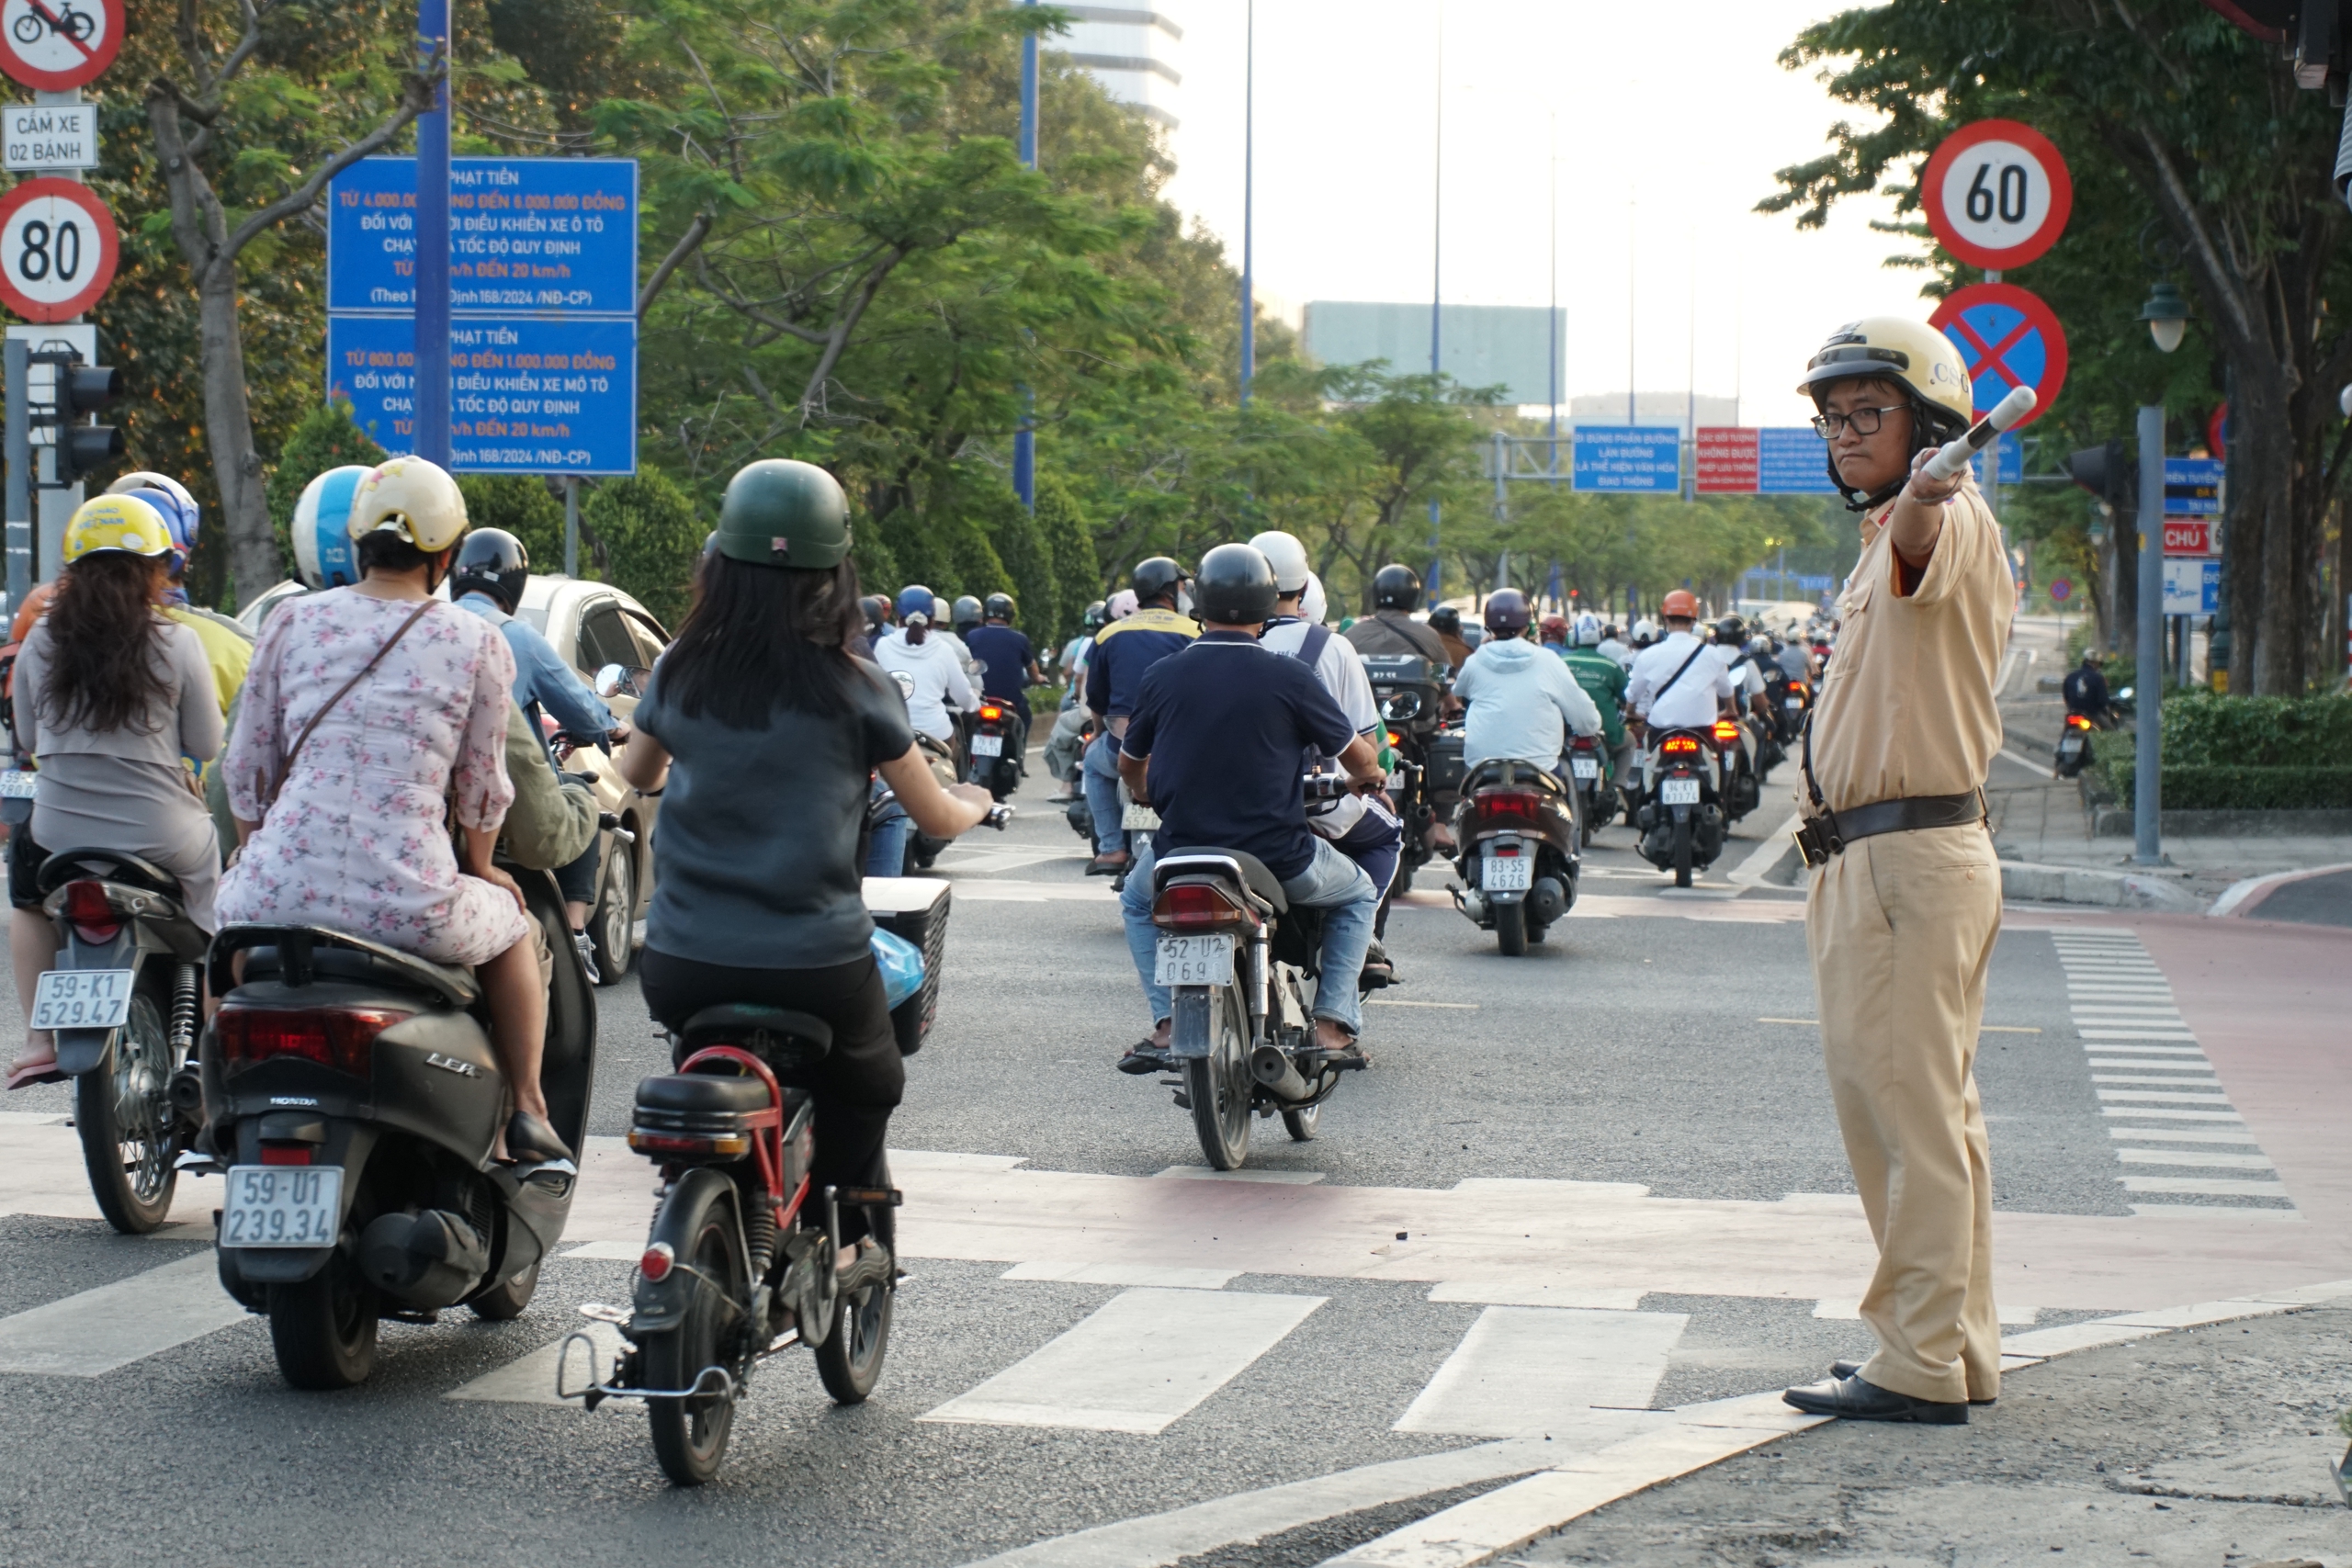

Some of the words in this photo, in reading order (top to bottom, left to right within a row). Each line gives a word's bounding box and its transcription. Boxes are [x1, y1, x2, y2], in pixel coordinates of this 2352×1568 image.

[17, 111, 53, 134] CẤM
[58, 116, 80, 133] XE
[9, 143, 28, 161] 02
[33, 140, 81, 162] BÁNH
[449, 170, 483, 187] PHẠT
[487, 165, 519, 185] TIỀN
[340, 188, 359, 207] TỪ
[363, 193, 417, 209] 4.000.00
[450, 194, 475, 209] NG
[478, 189, 510, 209] ĐẾN
[582, 189, 626, 210] ĐỒNG
[1966, 164, 2028, 224] 60
[361, 211, 386, 230] ĐỐI
[389, 212, 412, 230] VỚI
[464, 210, 497, 231] ĐIỀU
[501, 210, 546, 231] KHIỂN
[549, 218, 568, 232] XE
[571, 214, 582, 232] Ô
[585, 215, 604, 232] TÔ
[19, 220, 80, 281] 80
[383, 237, 417, 255] CHẠ
[458, 234, 486, 254] TỐC
[489, 236, 509, 257] ĐỘ
[512, 240, 541, 254] QUY
[545, 241, 581, 258] ĐỊNH
[477, 258, 508, 277] ĐẾN
[512, 263, 529, 277] 20
[532, 264, 571, 278] km/h
[370, 287, 408, 304] (Theo
[480, 289, 533, 304] 168/2024
[537, 290, 593, 306] /NĐ-CP)
[486, 325, 518, 344] TIỀN
[345, 347, 366, 366] TỪ
[368, 352, 414, 367] 800.00
[471, 348, 503, 367] ĐẾN
[507, 354, 569, 369] 1.000.000
[572, 349, 616, 370] ĐỒNG
[355, 370, 379, 389] ĐỐI
[382, 371, 405, 389] VỚI
[458, 370, 491, 390] ĐIỀU
[494, 370, 538, 391] KHIỂN
[542, 378, 561, 392] XE
[564, 375, 587, 392] MÔ
[590, 376, 608, 392] TÔ
[382, 397, 414, 414] CHẠ
[458, 393, 485, 412] TỐC
[488, 397, 508, 416] ĐỘ
[511, 400, 540, 413] QUY
[544, 400, 580, 416] ĐỊNH
[476, 418, 507, 436] ĐẾN
[511, 422, 528, 437] 20
[531, 423, 571, 437] km/h
[479, 448, 533, 463] 168/2024
[536, 449, 592, 466] /NĐ-CP)
[2165, 525, 2200, 547] CHÚ
[1490, 874, 1524, 888] 4626
[51, 975, 116, 999] 59-K1
[38, 999, 122, 1024] 529.47
[269, 1097, 319, 1106] HONDA
[243, 1171, 322, 1205] 59-U1
[230, 1209, 329, 1241] 239.34
